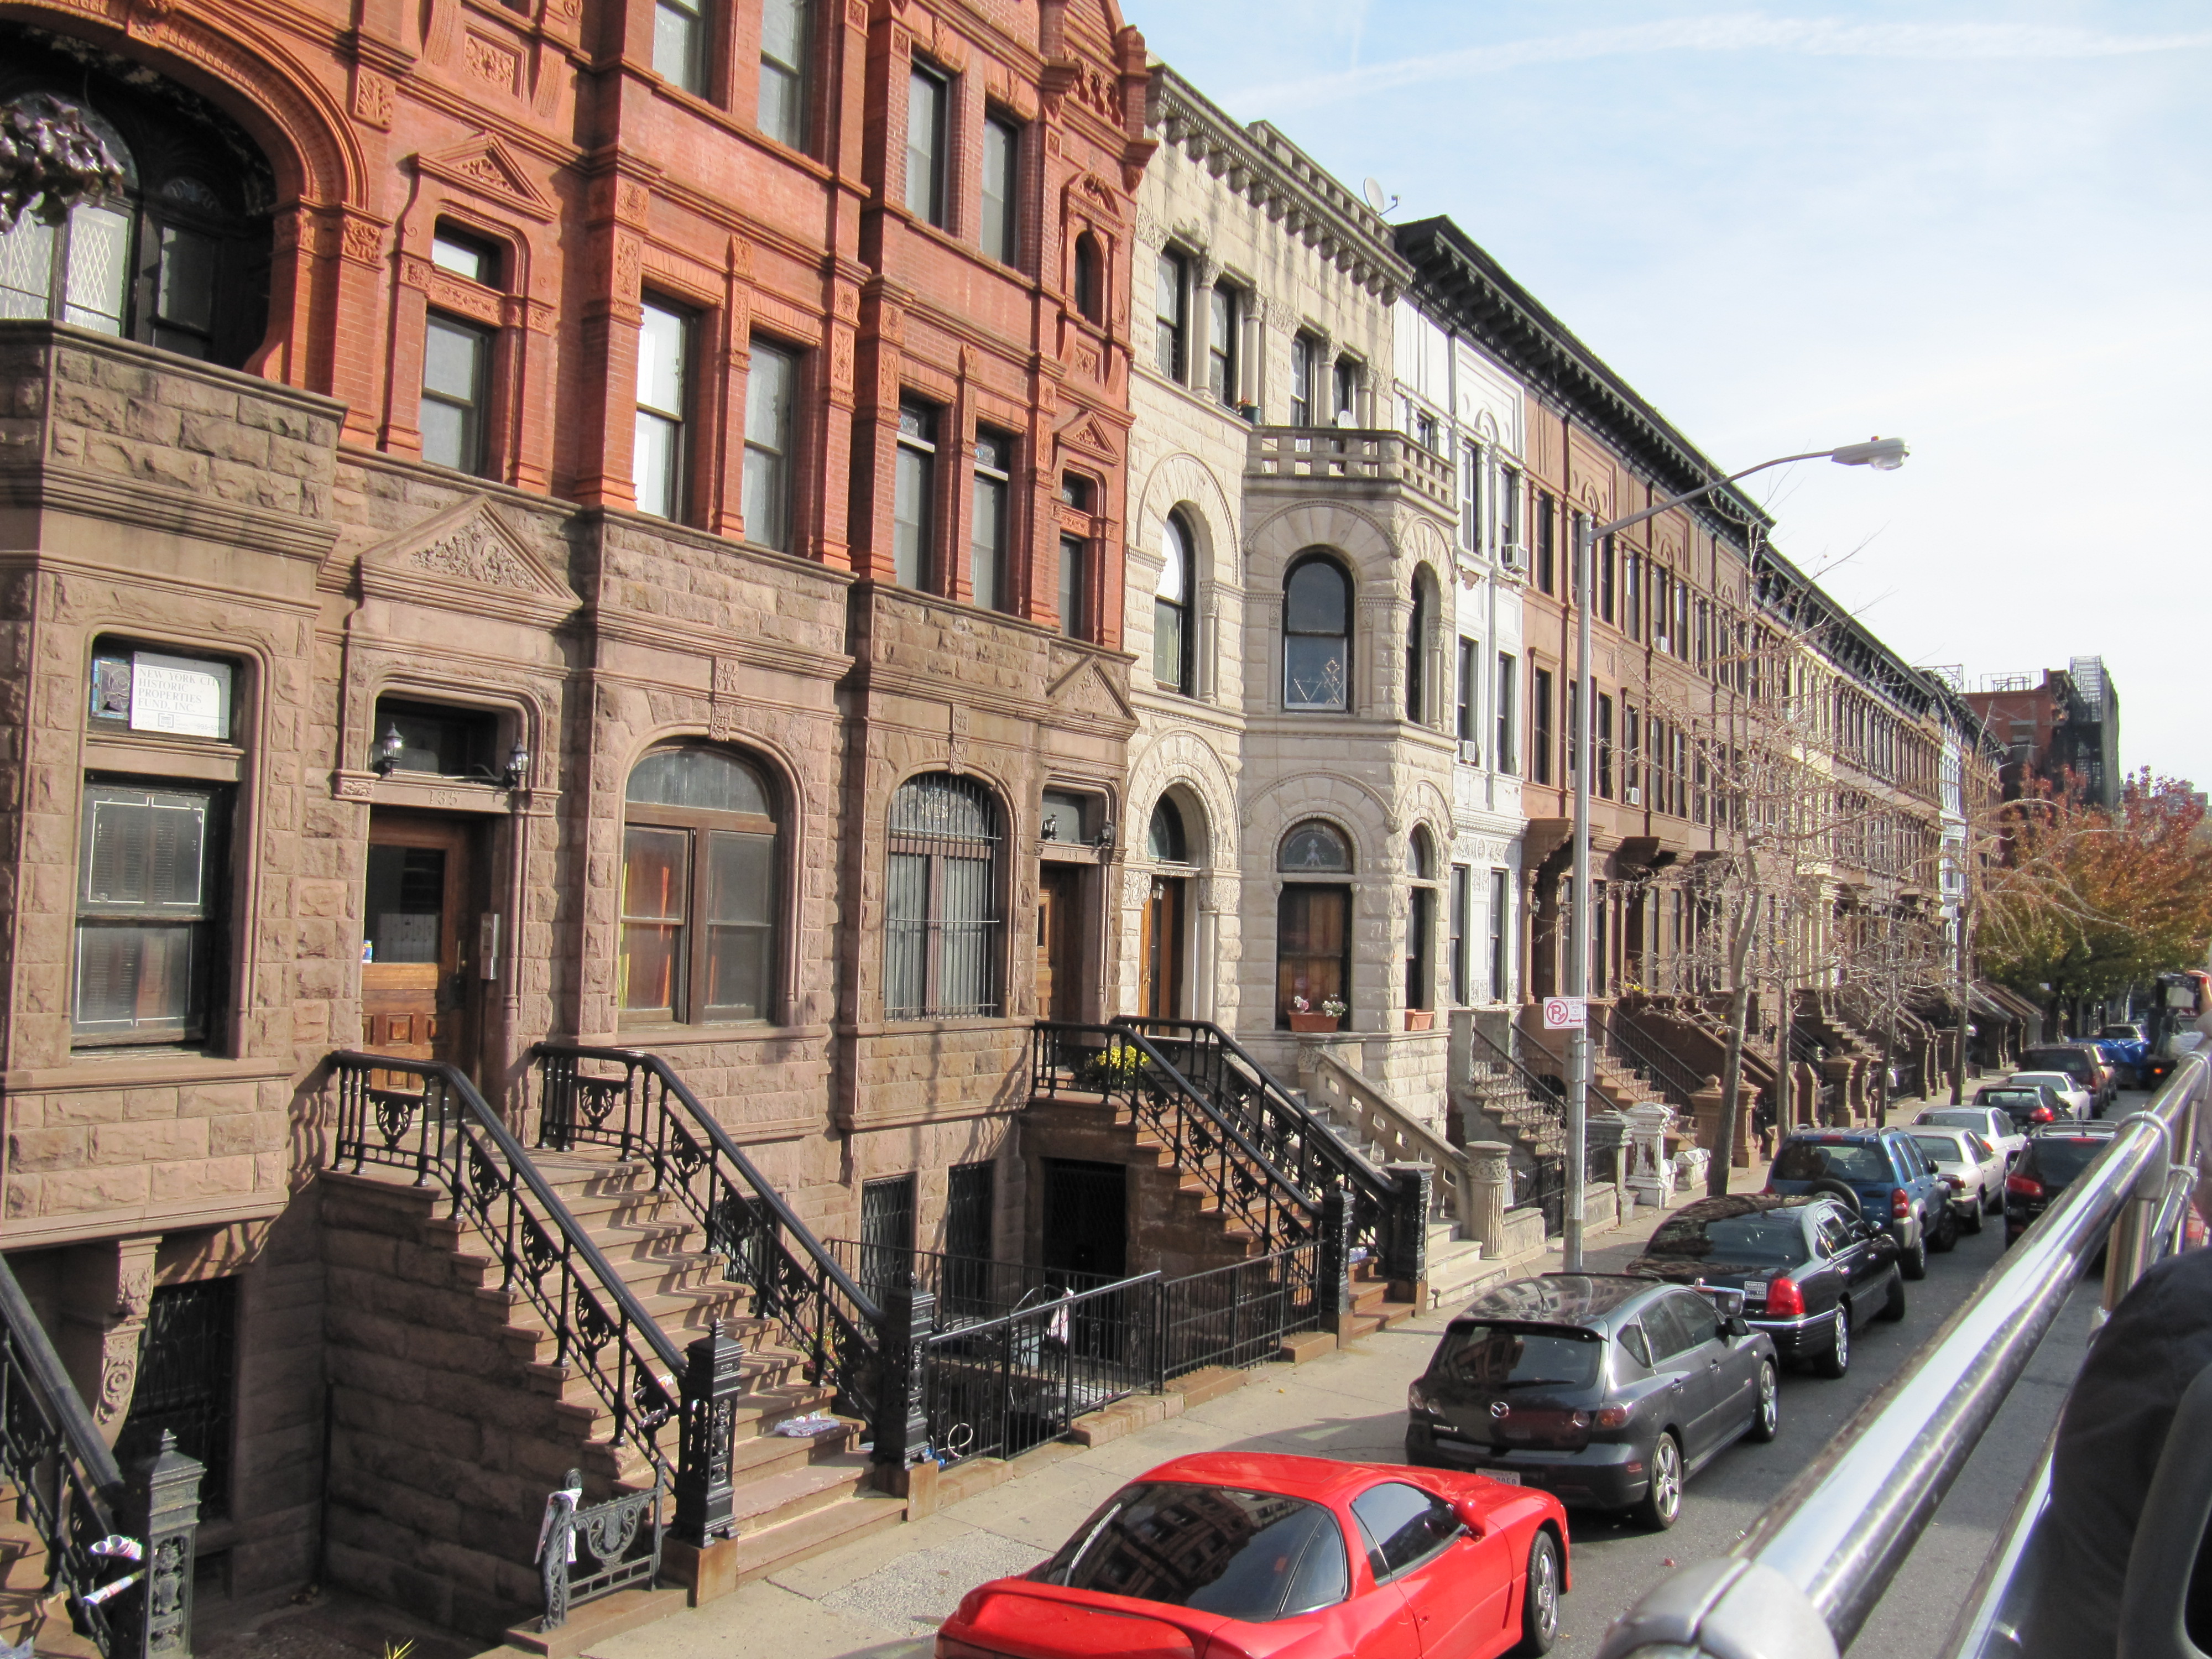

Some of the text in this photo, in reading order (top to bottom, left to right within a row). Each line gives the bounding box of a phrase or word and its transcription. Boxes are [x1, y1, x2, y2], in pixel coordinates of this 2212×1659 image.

[139, 667, 163, 679] NEW
[169, 671, 195, 684] YORK
[138, 678, 189, 691] HISTORIC
[138, 688, 202, 703] PROPERTIES
[175, 702, 195, 712] INC.
[428, 790, 458, 806] 135
[1061, 849, 1078, 861] 133
